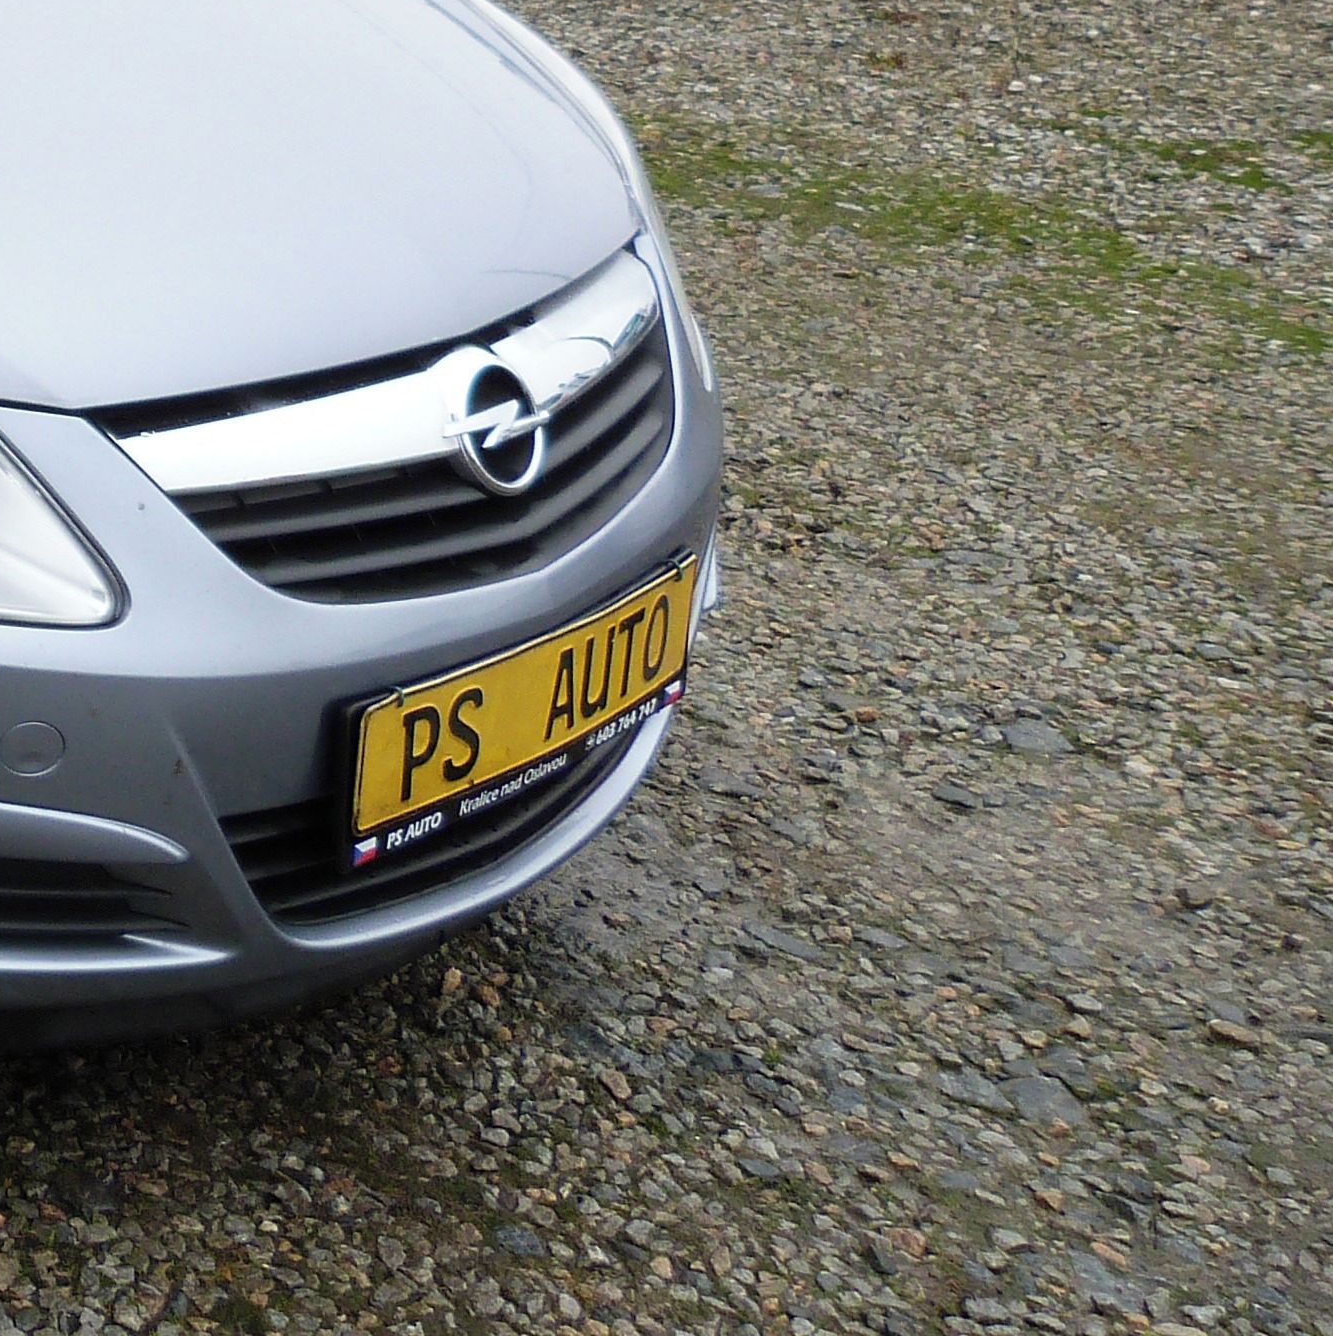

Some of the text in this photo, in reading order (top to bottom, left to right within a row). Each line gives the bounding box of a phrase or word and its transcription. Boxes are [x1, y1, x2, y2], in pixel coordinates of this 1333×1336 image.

[400, 595, 669, 801] PS AUTO
[387, 829, 403, 849] PS
[405, 811, 442, 842] AUTO
[459, 788, 499, 816] Kralice
[500, 774, 522, 797] nad
[524, 753, 567, 784] Oslavou
[596, 722, 616, 744] 603
